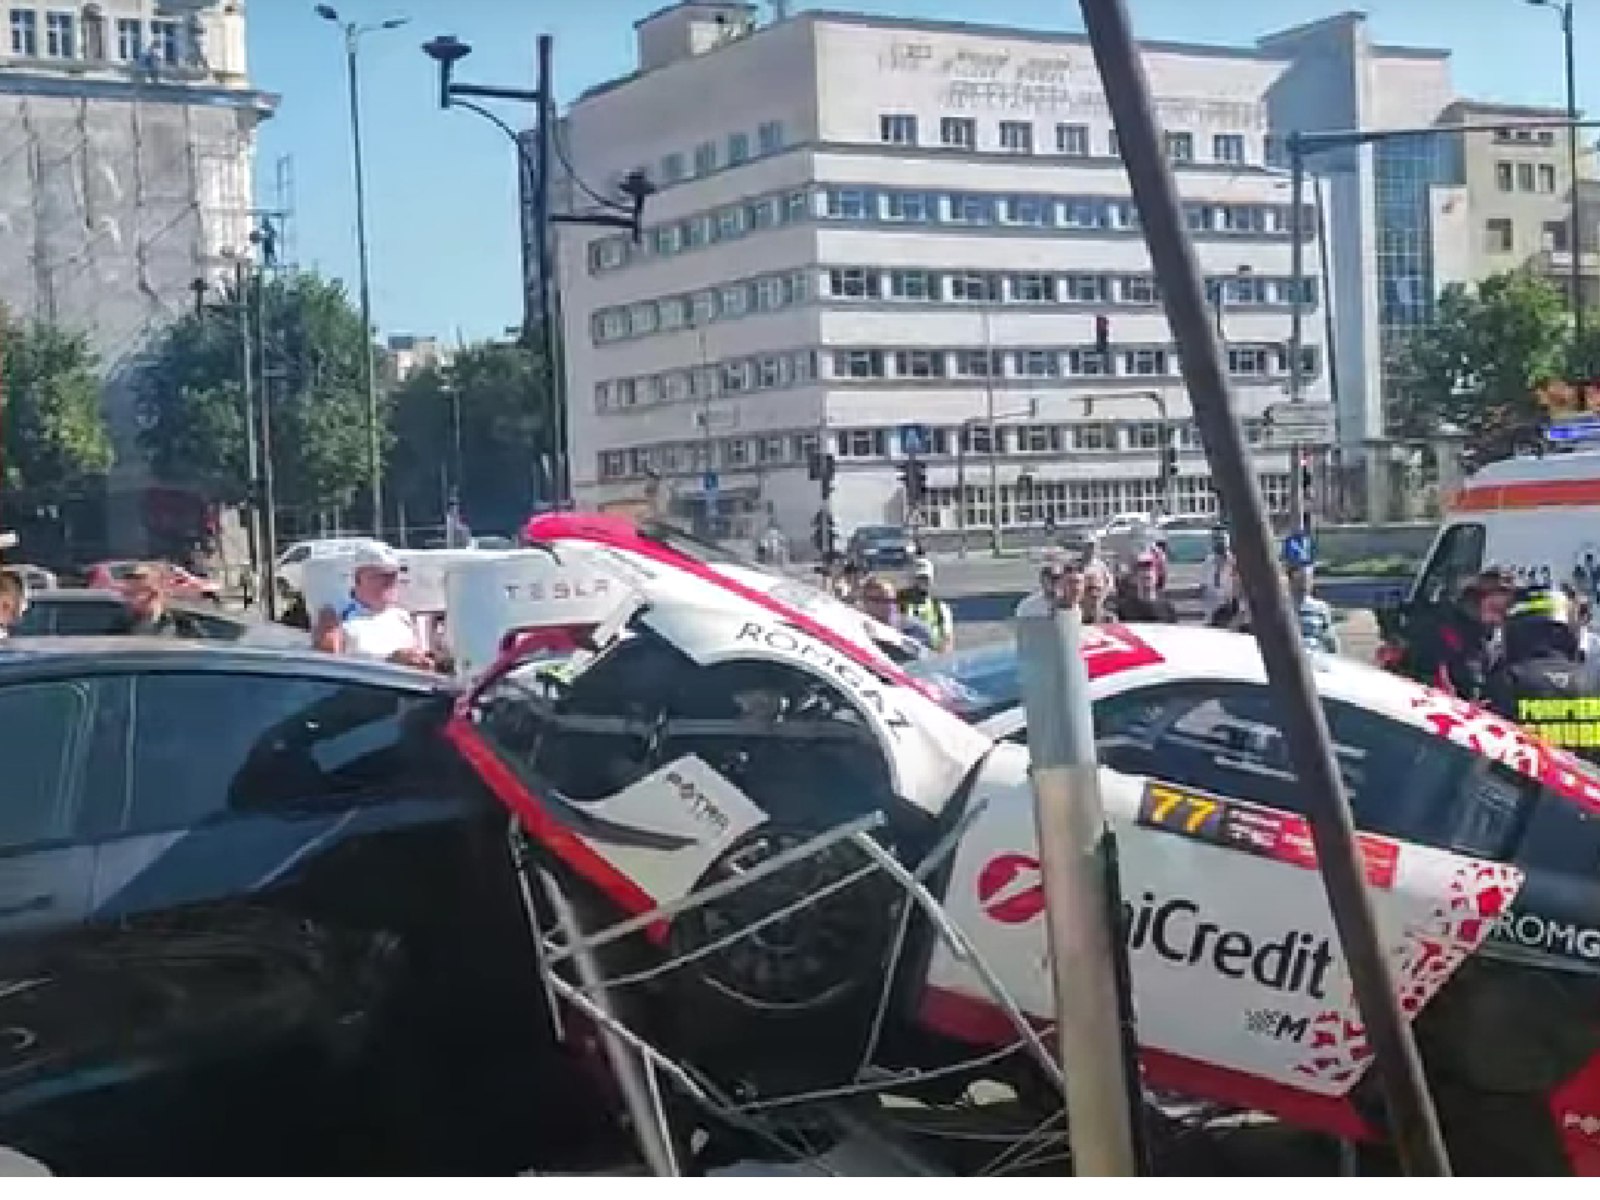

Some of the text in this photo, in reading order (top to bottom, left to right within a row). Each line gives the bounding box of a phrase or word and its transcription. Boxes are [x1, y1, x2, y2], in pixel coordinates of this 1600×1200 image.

[504, 579, 609, 601] TESLA
[1150, 786, 1218, 834] 77
[1121, 890, 1332, 1000] iCredit
